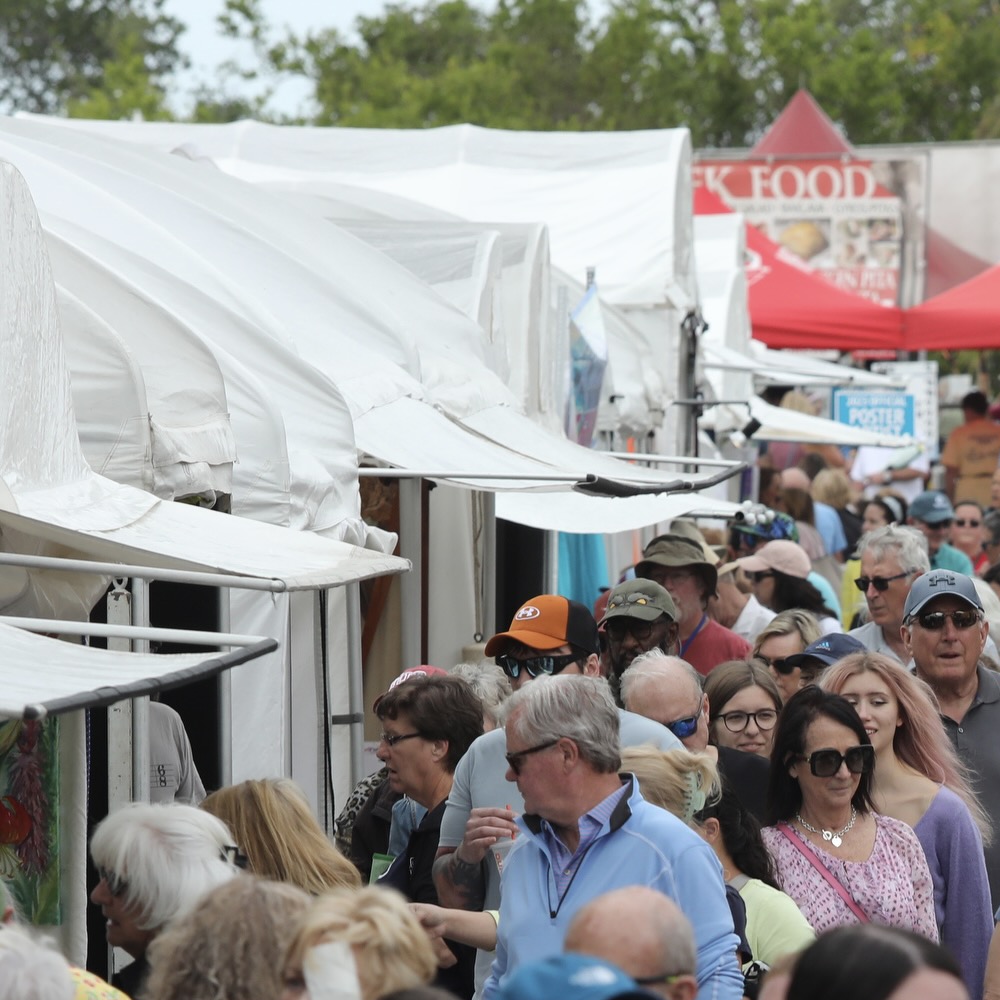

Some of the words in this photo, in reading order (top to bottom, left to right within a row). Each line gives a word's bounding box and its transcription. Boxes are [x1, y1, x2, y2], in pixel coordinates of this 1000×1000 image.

[750, 165, 876, 199] FOOD
[850, 408, 905, 426] POSTER
[157, 764, 166, 776] 6
[159, 775, 167, 788] 8
